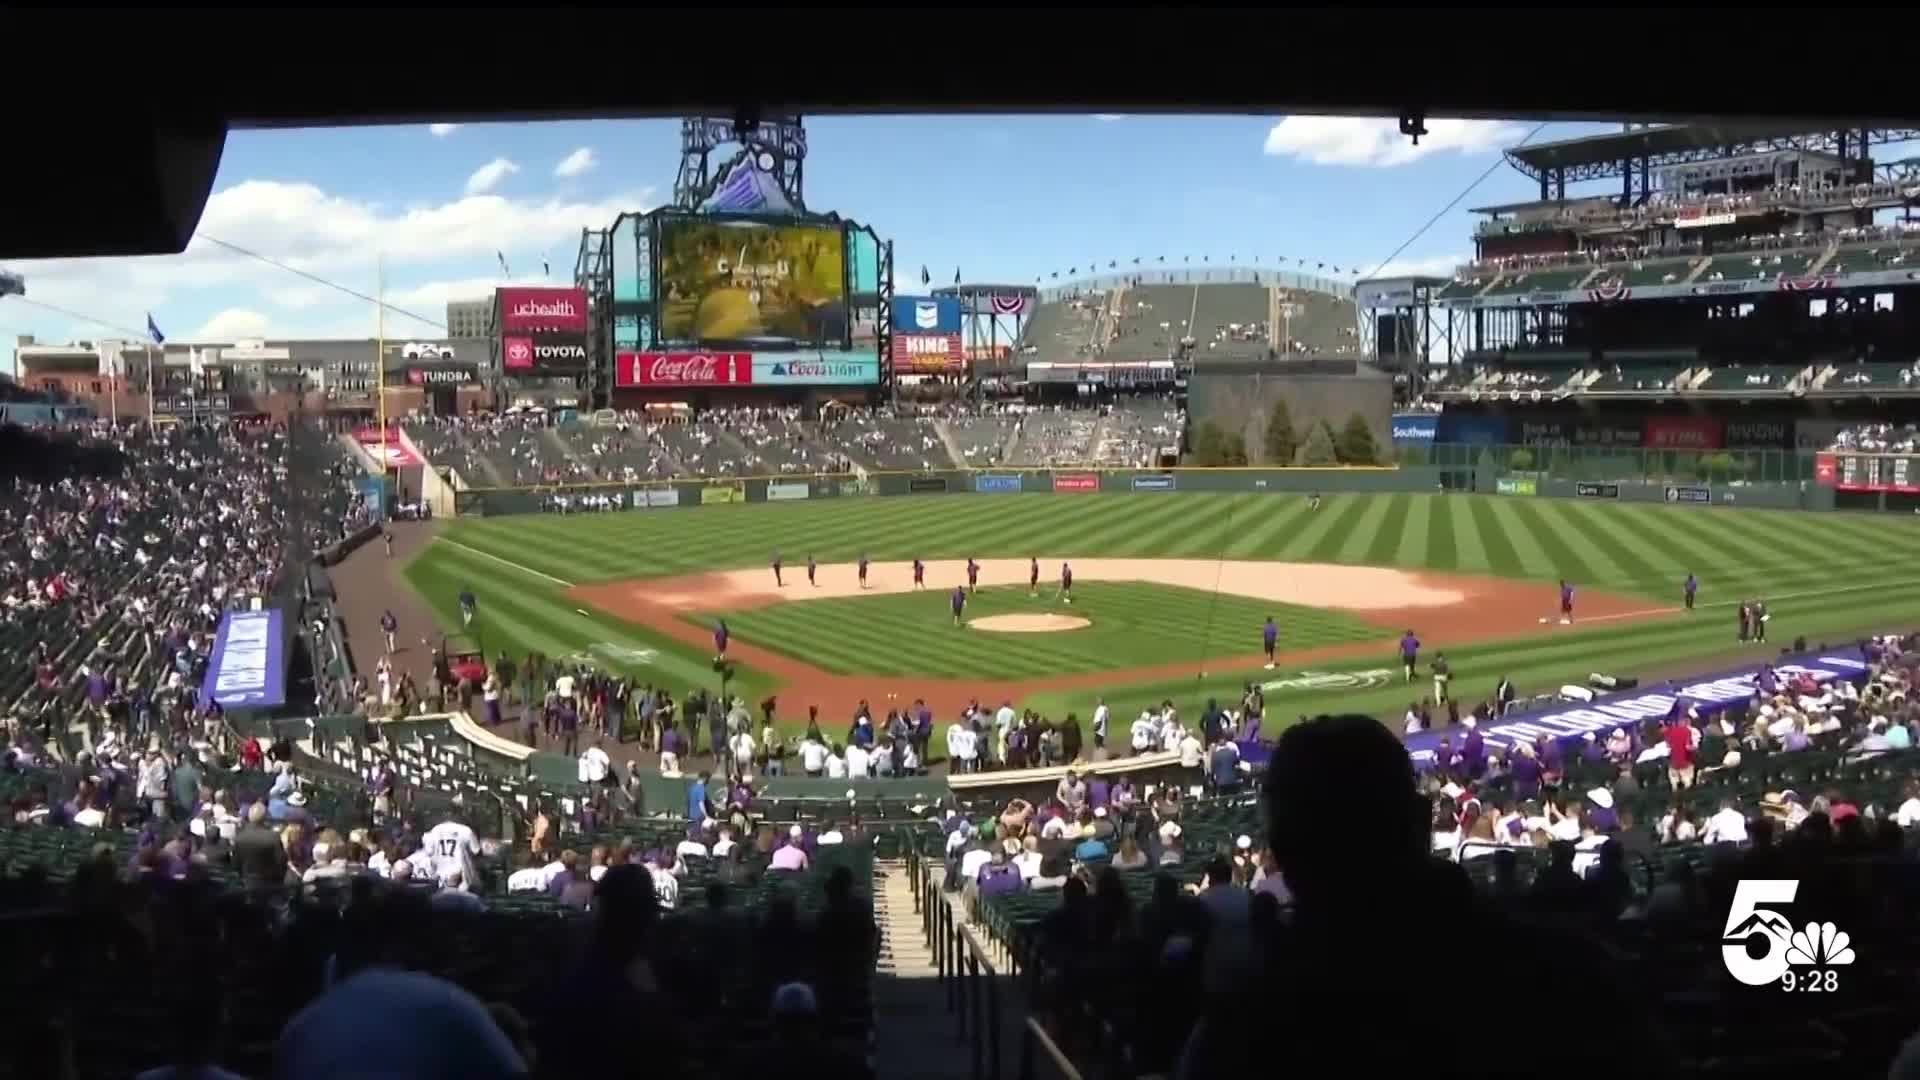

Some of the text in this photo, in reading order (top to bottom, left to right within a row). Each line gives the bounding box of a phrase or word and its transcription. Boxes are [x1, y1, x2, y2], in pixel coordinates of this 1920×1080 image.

[513, 299, 576, 316] uchealth
[534, 345, 586, 359] TOYOTA
[423, 371, 472, 383] TUNDRA
[440, 839, 456, 857] 17
